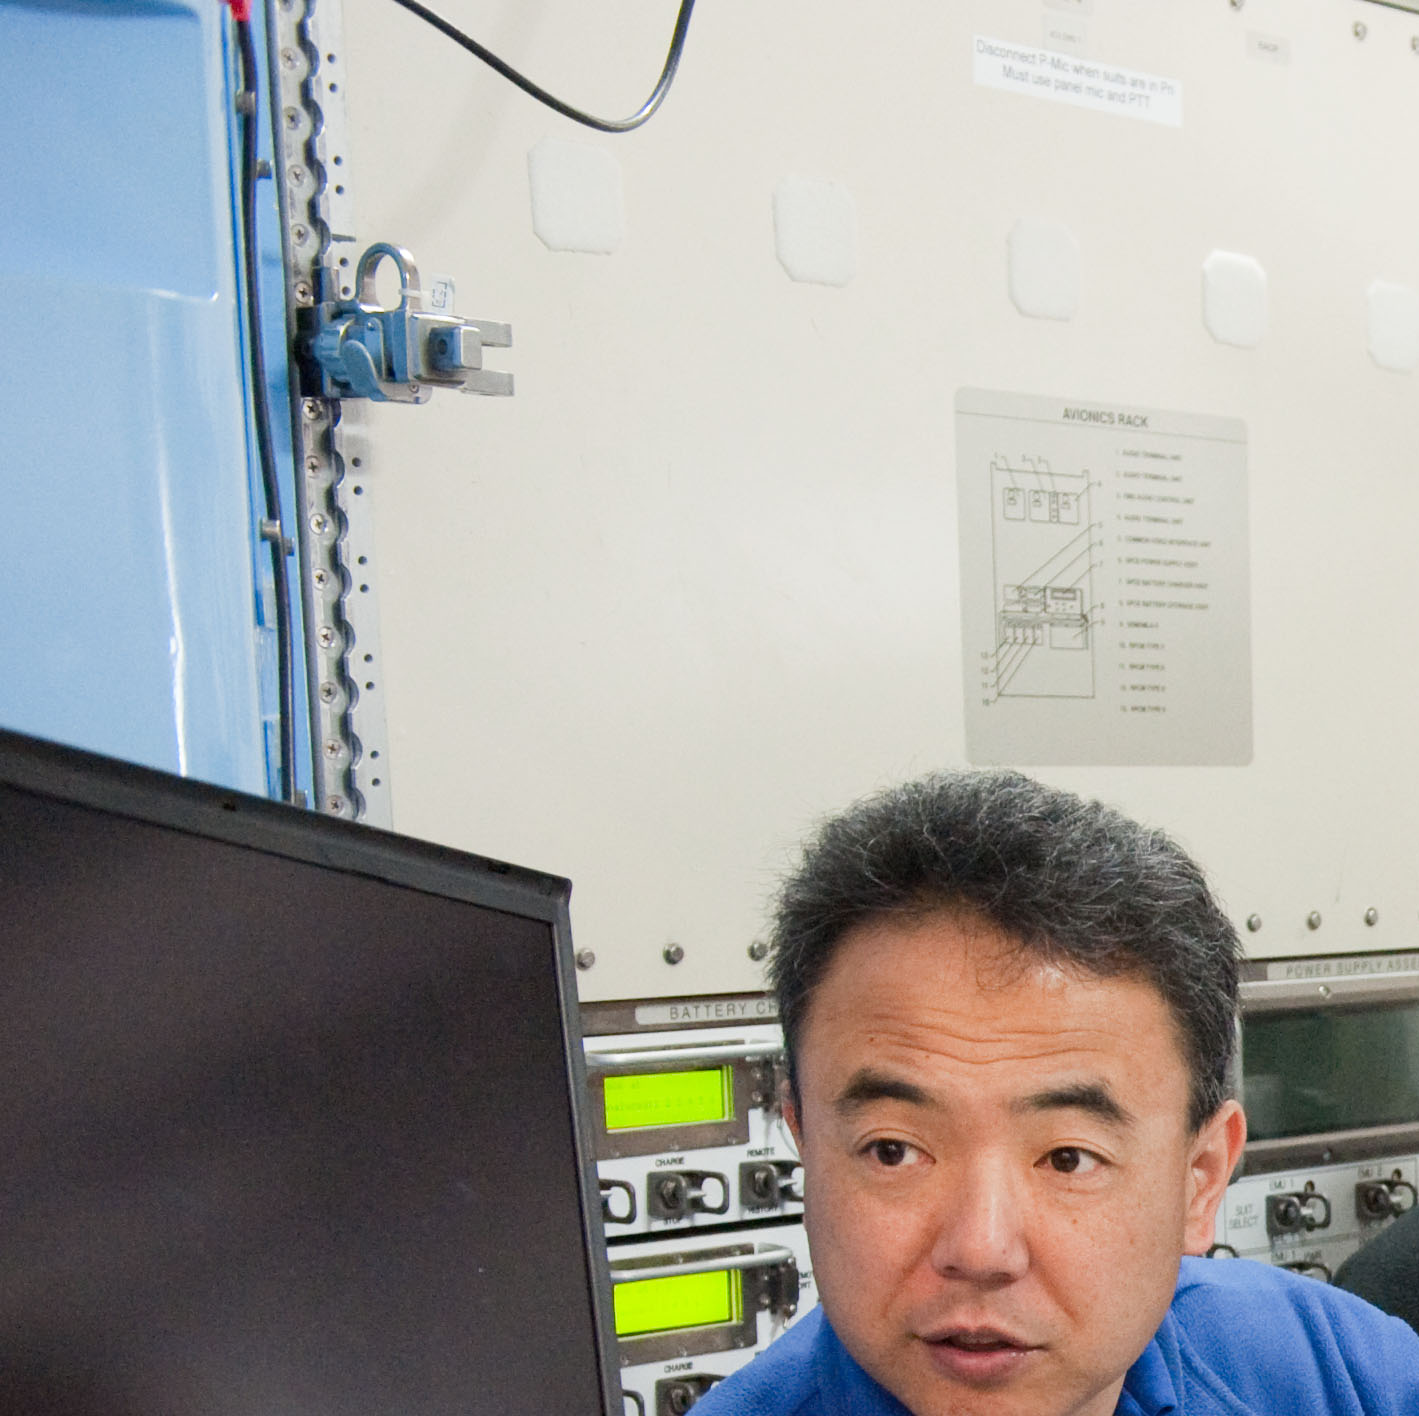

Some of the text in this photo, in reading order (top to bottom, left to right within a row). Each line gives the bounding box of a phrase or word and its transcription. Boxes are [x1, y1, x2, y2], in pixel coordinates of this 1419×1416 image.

[1062, 407, 1149, 428] AVIONICS RACK
[1286, 964, 1331, 978] POWER
[1336, 960, 1383, 976] SUPPLY
[670, 1001, 747, 1021] BATTERY
